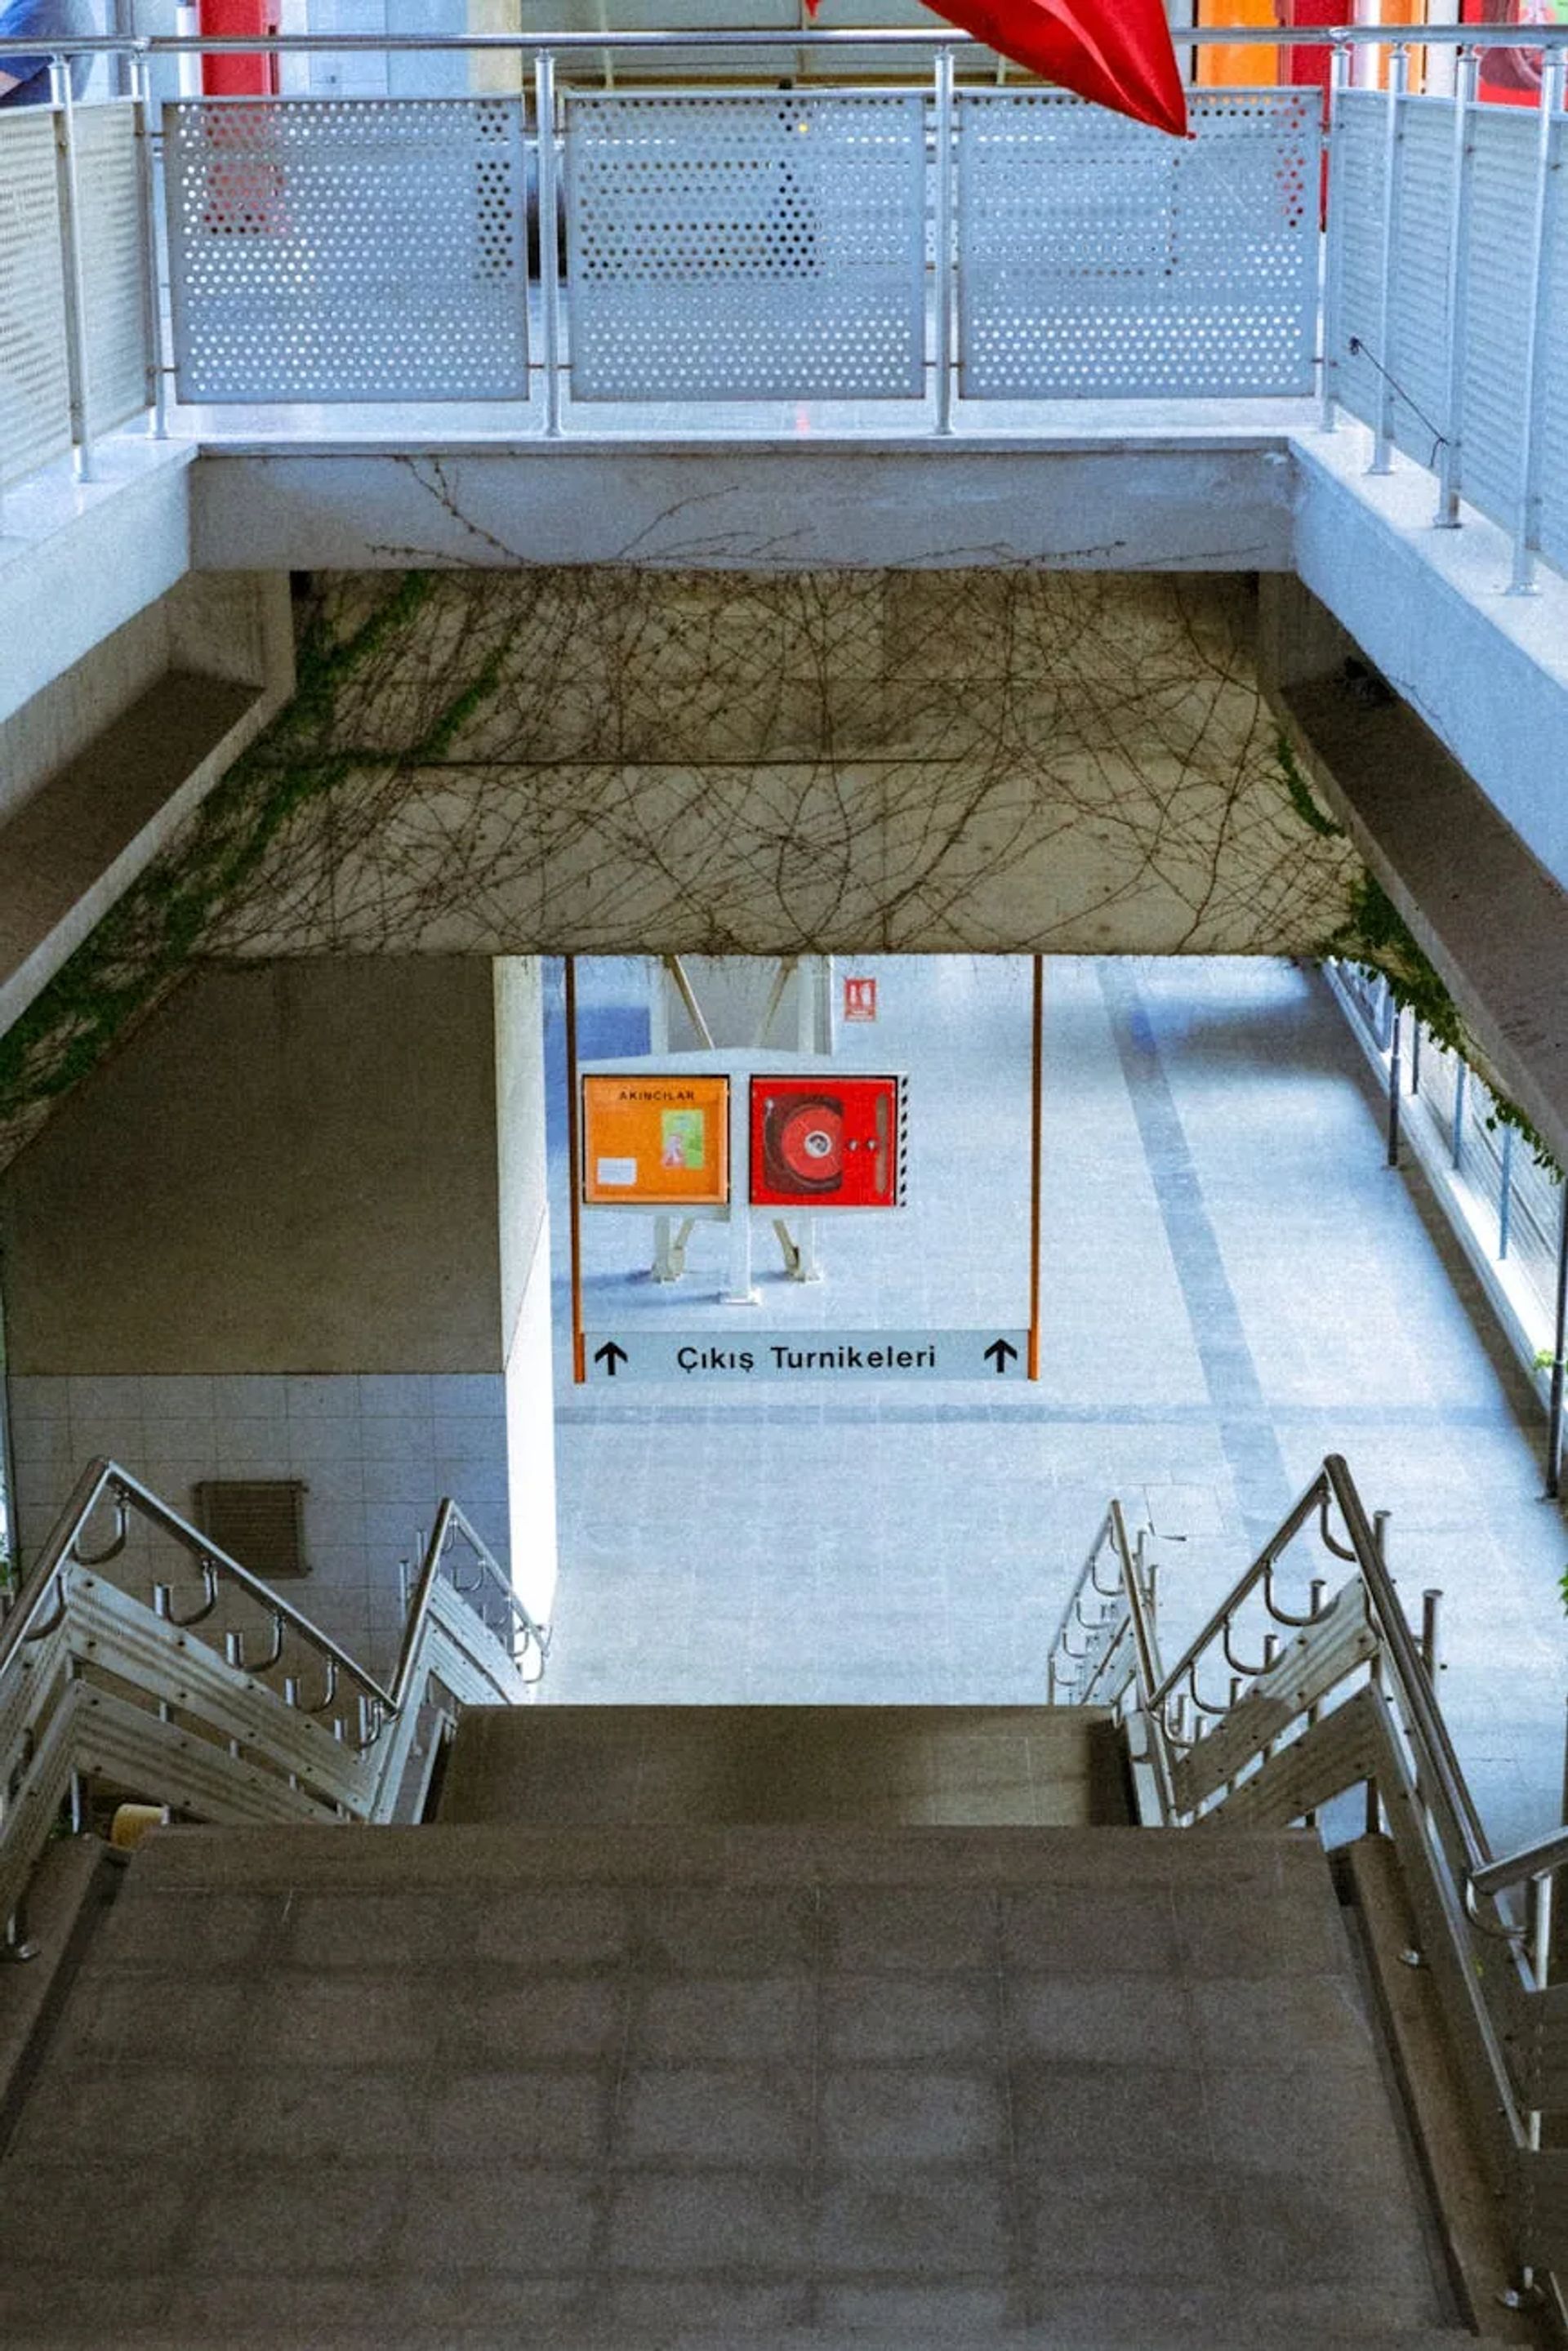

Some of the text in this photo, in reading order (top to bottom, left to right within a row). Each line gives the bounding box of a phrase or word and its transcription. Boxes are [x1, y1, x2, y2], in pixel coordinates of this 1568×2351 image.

[620, 1090, 694, 1101] AKINCILAR
[677, 1345, 936, 1374] Çıkış Turnikeleri
